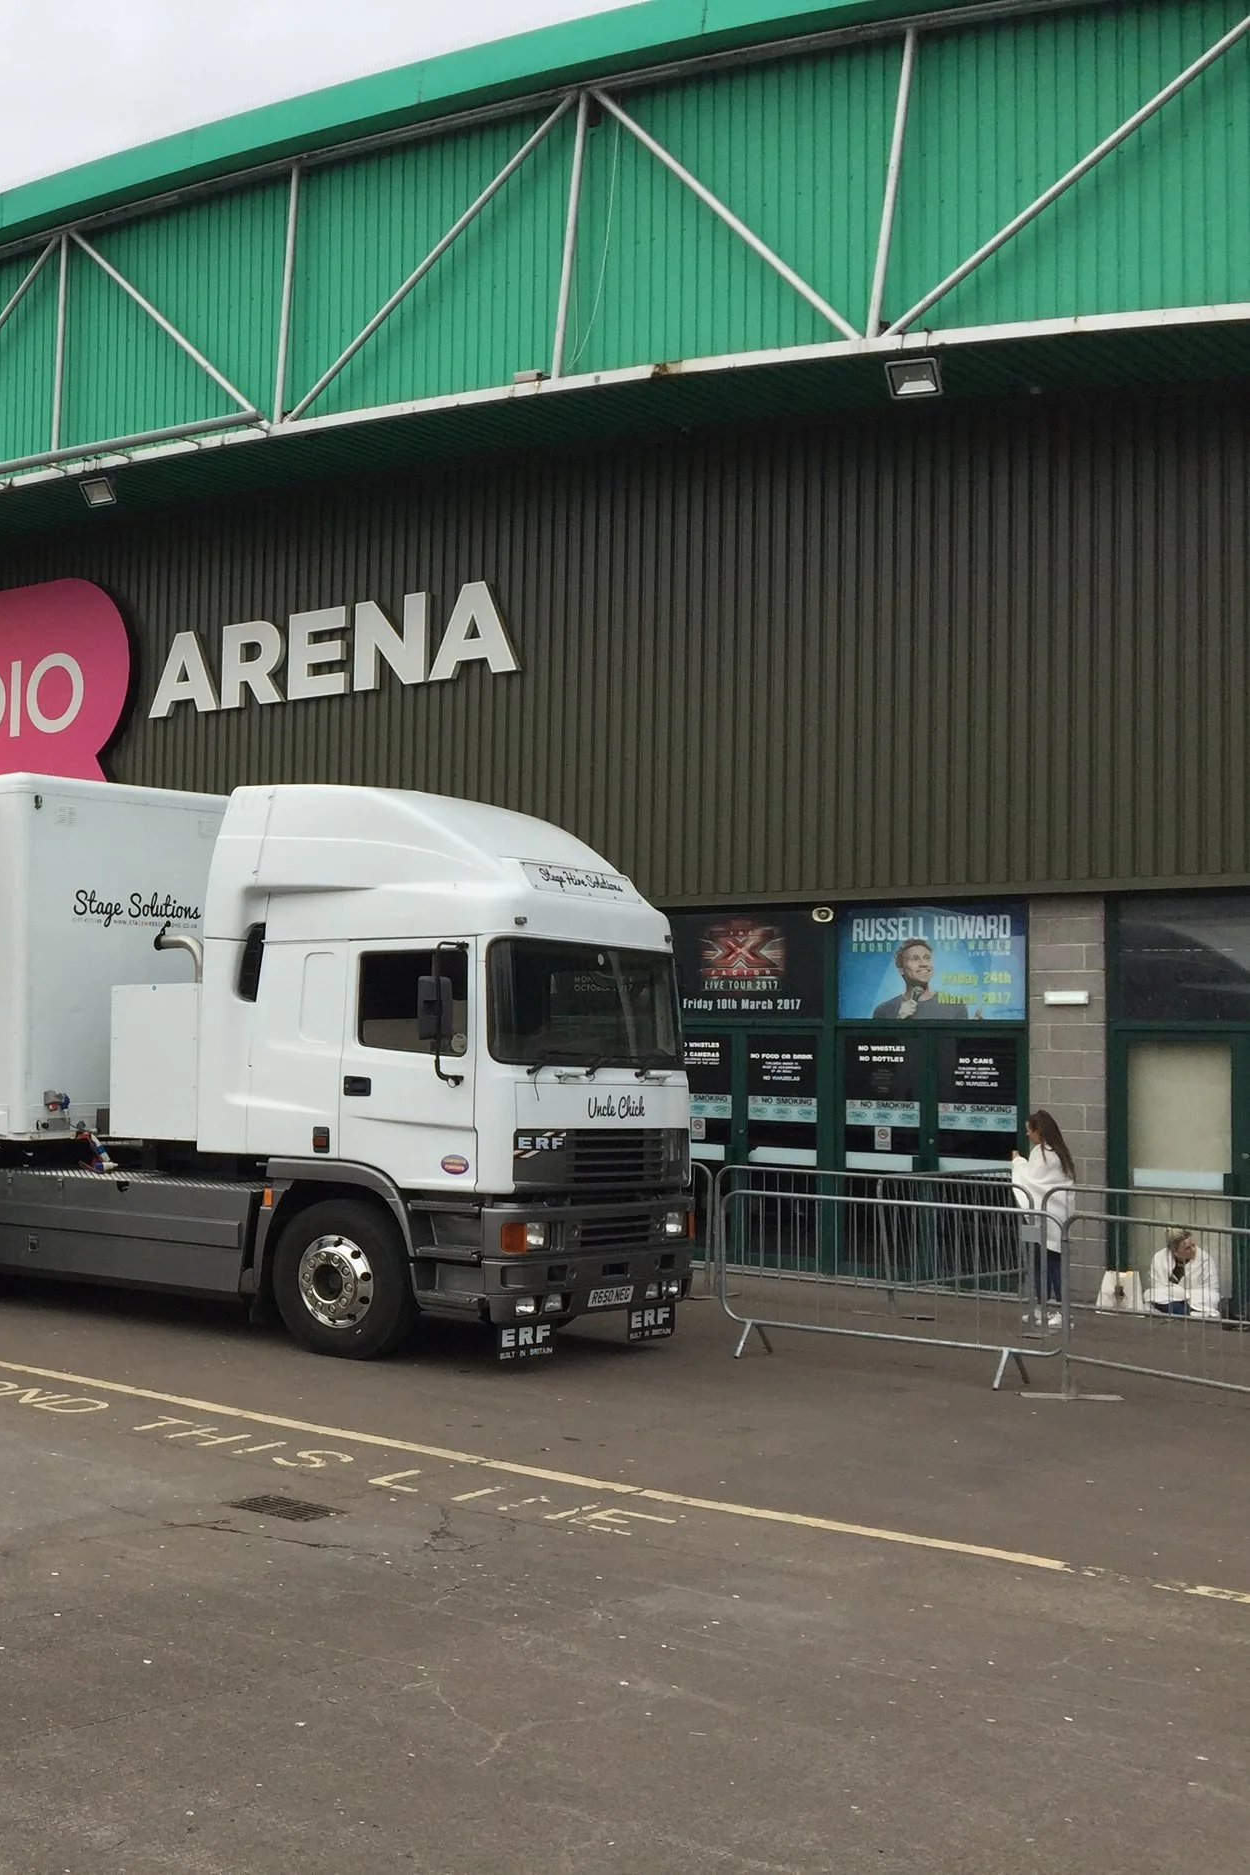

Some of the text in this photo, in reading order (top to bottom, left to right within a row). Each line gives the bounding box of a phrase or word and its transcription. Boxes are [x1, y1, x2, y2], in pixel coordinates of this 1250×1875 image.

[150, 581, 521, 718] ARENA
[538, 868, 623, 892] Stage Hire Solutions
[73, 890, 201, 927] Stage Solutions
[852, 915, 1011, 941] RUSSELL HOWARD
[705, 981, 778, 989] LIVE TOUR 2017
[942, 971, 1012, 986] Friday 24th
[683, 998, 801, 1010] Friday 10th March 2017
[938, 992, 1011, 1004] March 2017
[587, 1096, 645, 1119] Uncle Chick
[518, 1136, 565, 1150] ERF
[591, 1287, 631, 1304] R650 NEG
[631, 1307, 671, 1329] ERF
[501, 1324, 551, 1348] ERF
[529, 1347, 553, 1356] BRITAIN
[134, 1415, 354, 1469] THIS
[368, 1469, 677, 1536] LINE
